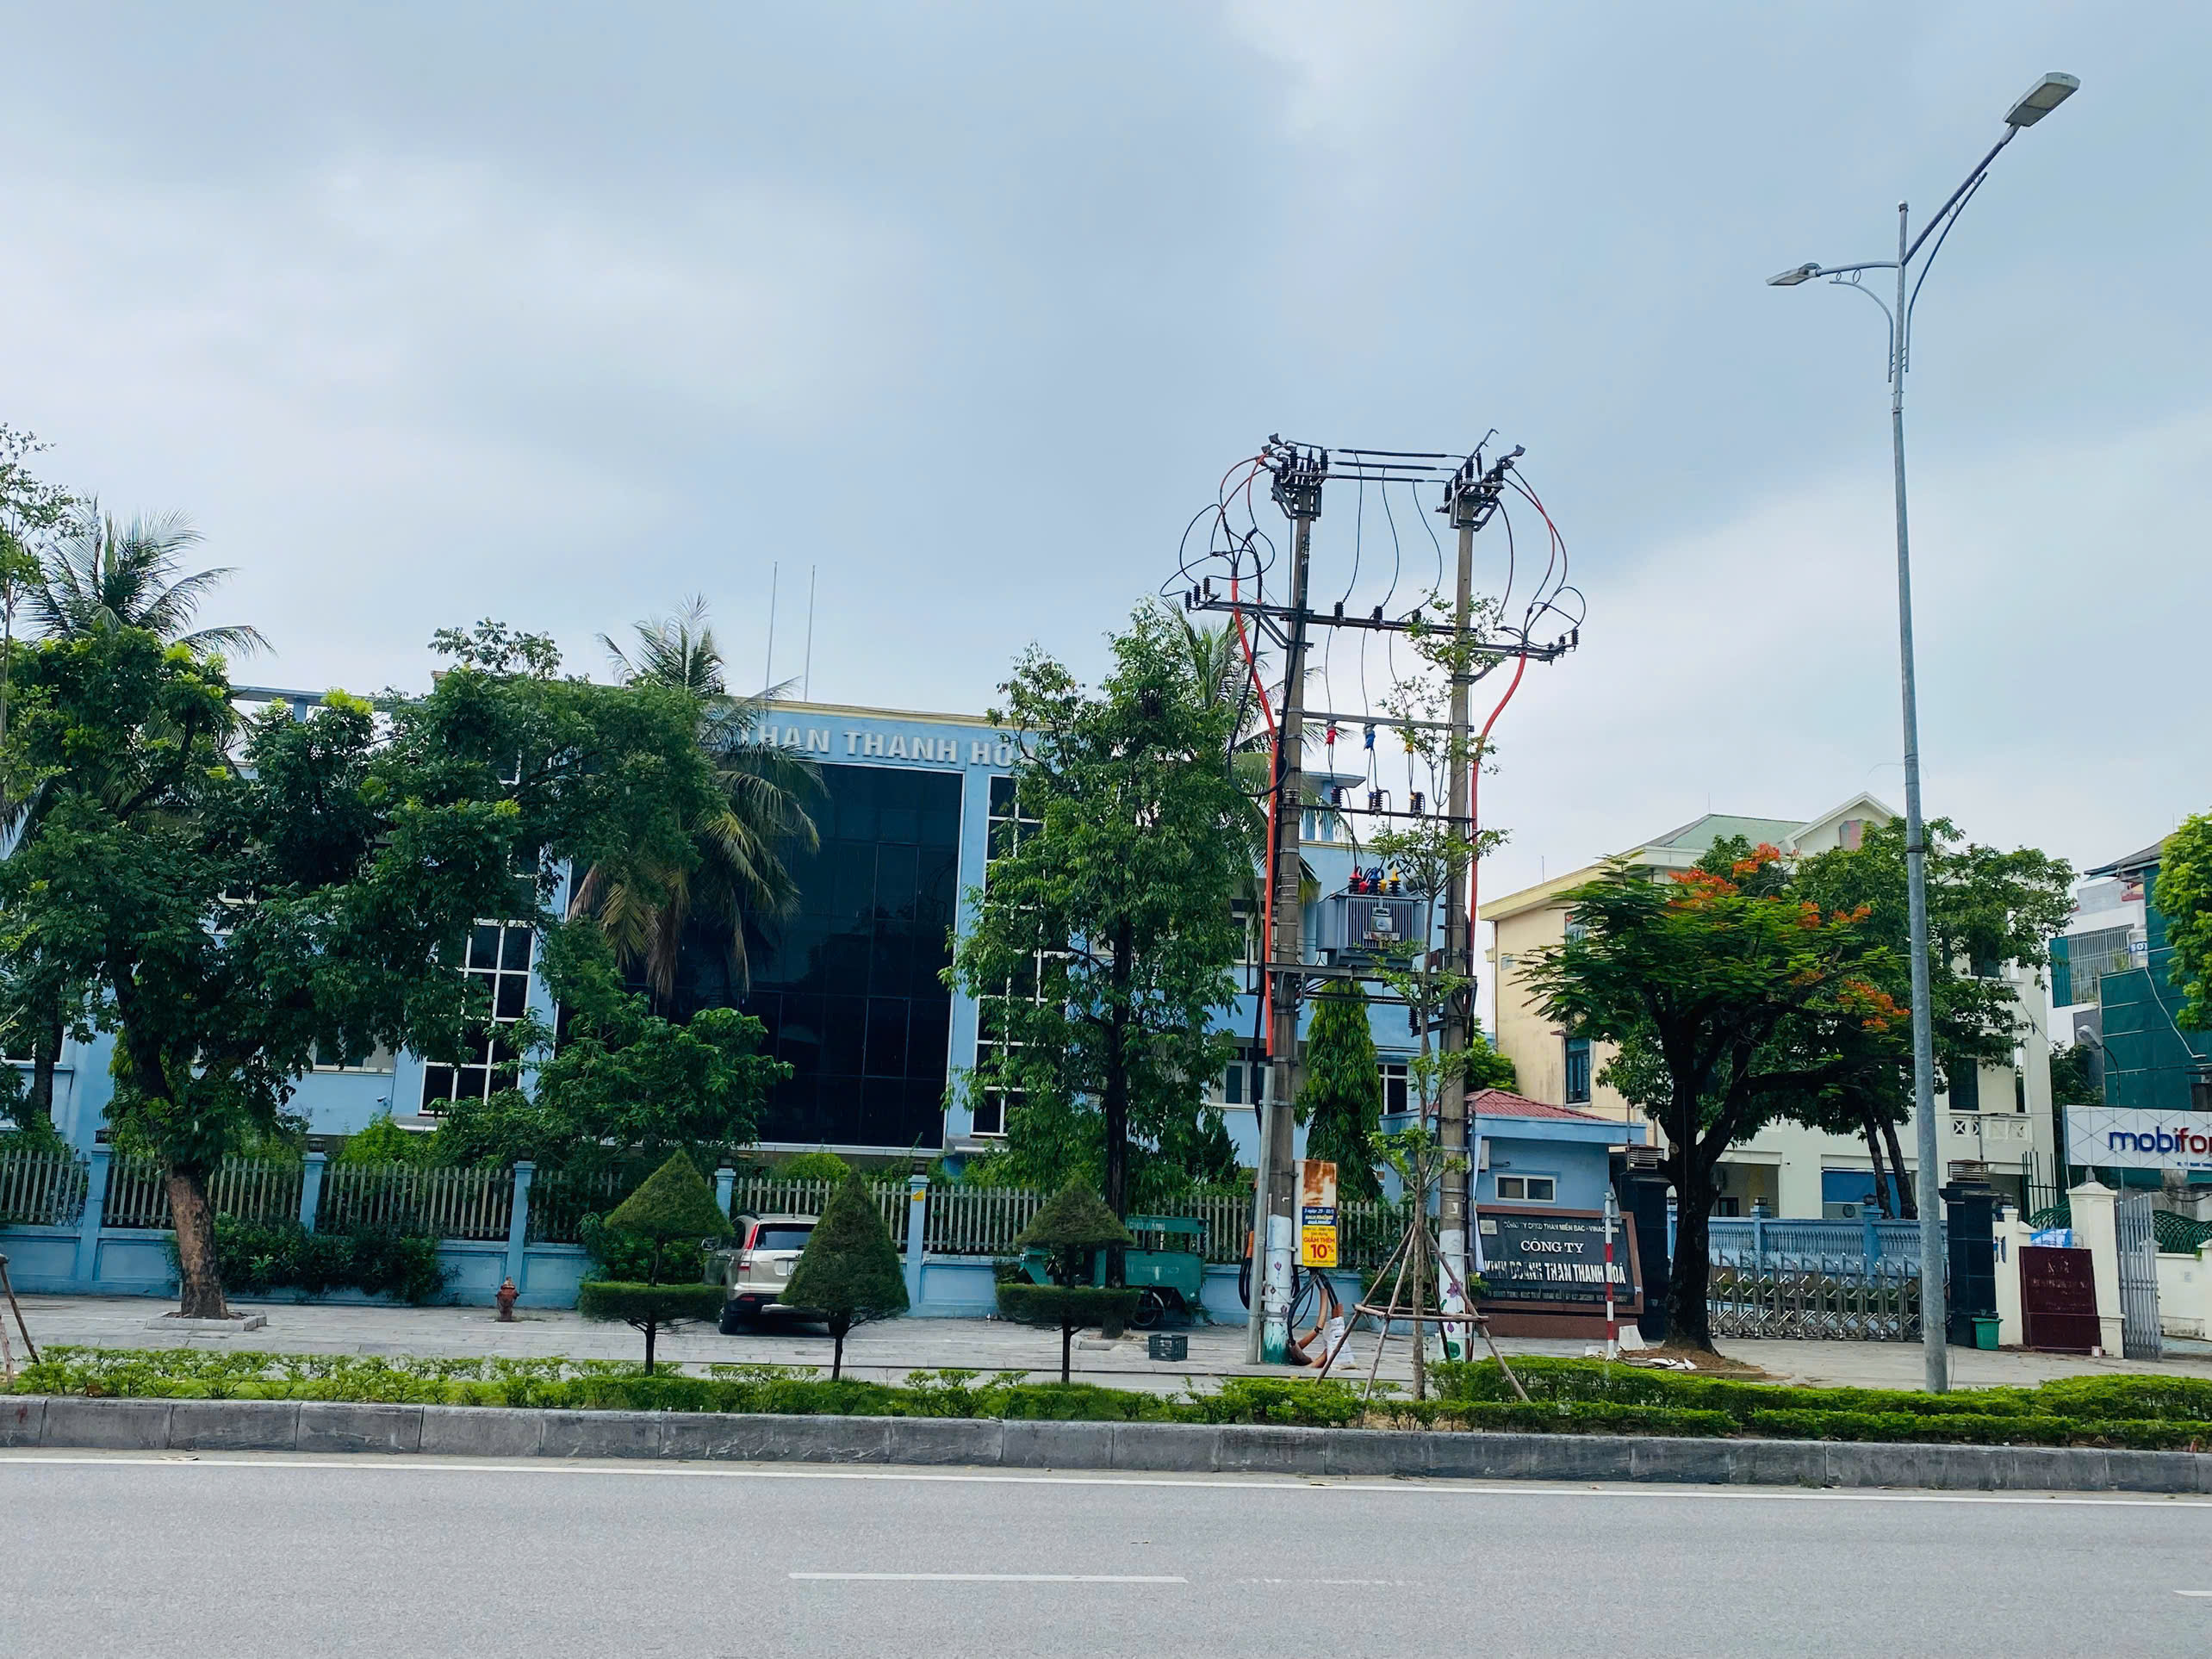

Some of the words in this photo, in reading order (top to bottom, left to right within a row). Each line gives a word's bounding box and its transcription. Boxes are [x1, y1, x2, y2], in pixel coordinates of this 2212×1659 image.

[843, 730, 957, 764] THANH
[2109, 1126, 2212, 1153] mobifo
[1520, 1237, 1563, 1252] CÔNG
[1564, 1242, 1585, 1253] TY
[1544, 1262, 1572, 1282] THAN
[1572, 1264, 1605, 1283] THANH
